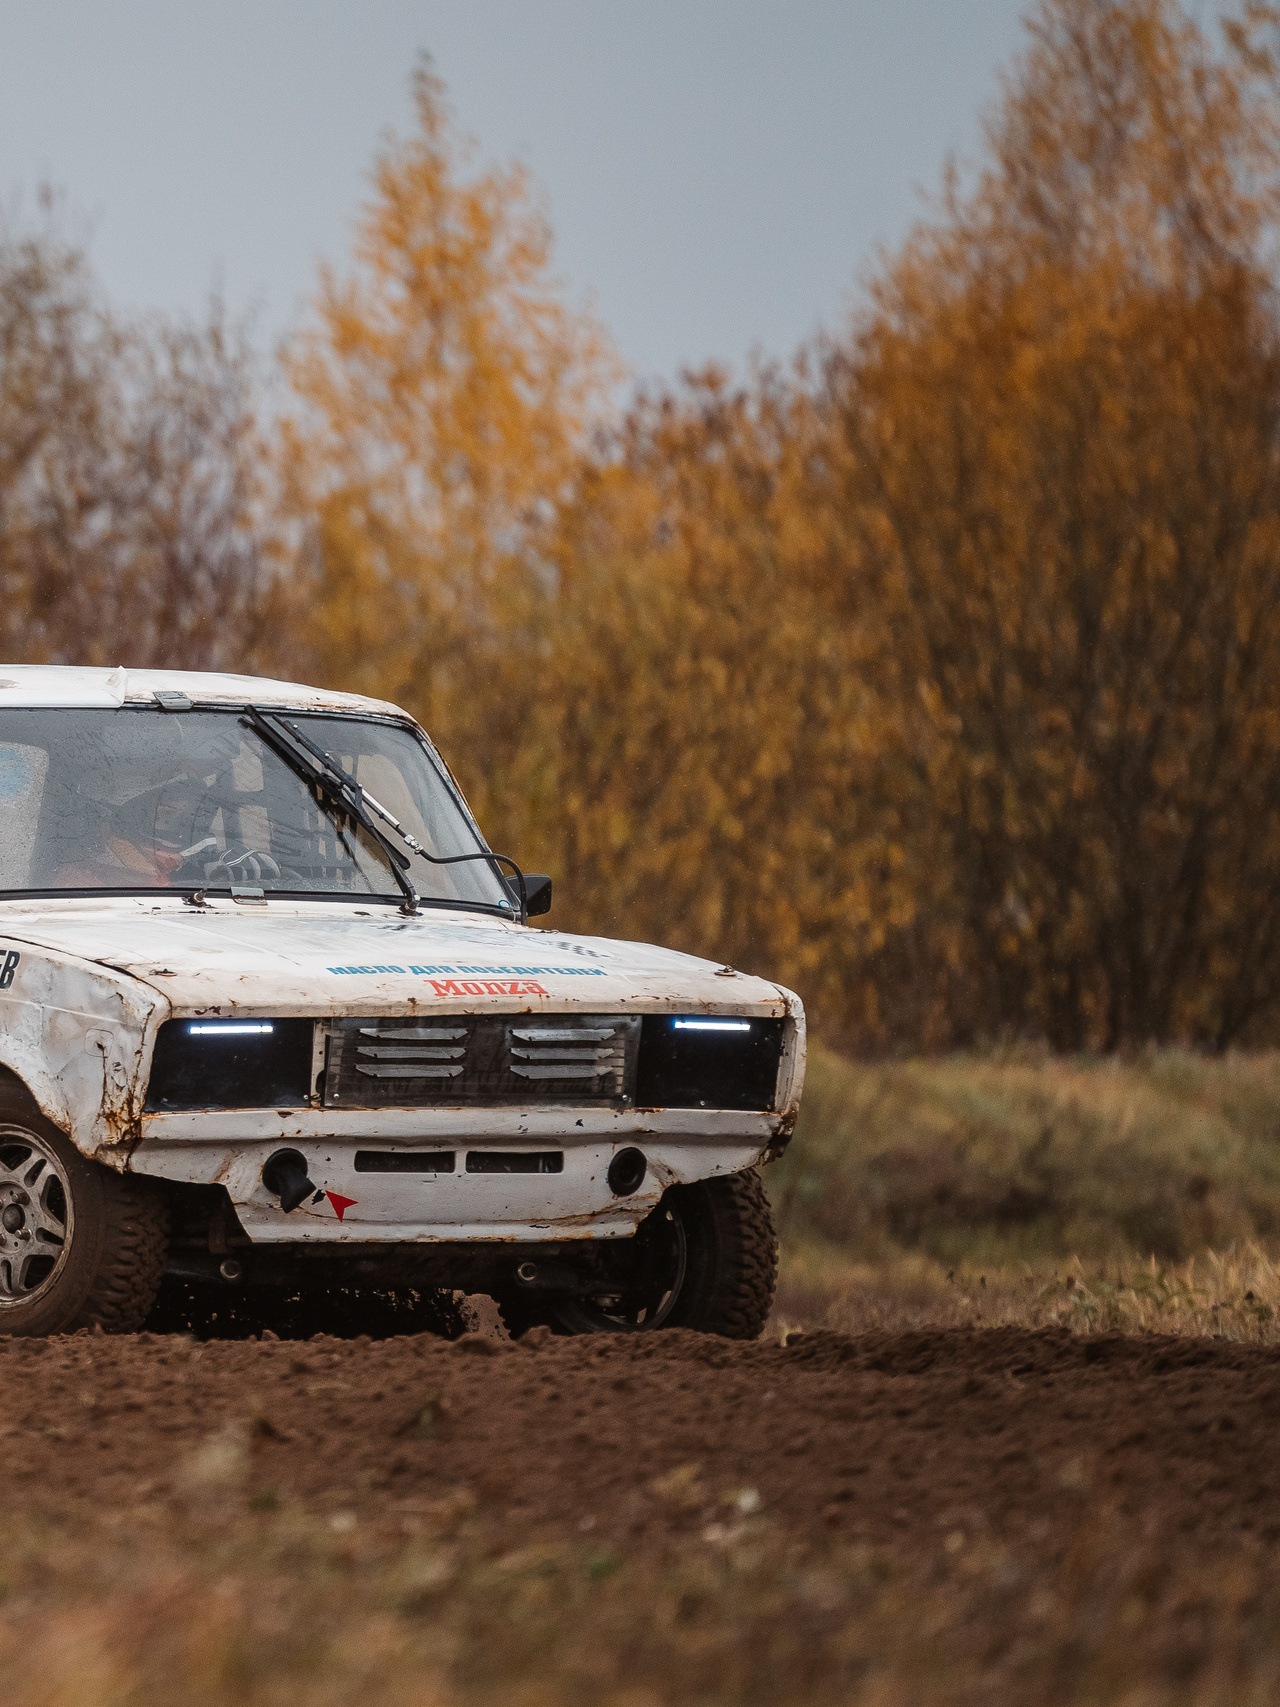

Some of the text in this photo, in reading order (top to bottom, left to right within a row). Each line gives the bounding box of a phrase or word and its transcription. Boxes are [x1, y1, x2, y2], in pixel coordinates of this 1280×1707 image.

[326, 965, 609, 976] МАСЛО ДЛЯ ПОБЕДИТЕЛЕЙ
[423, 979, 549, 996] Monza
